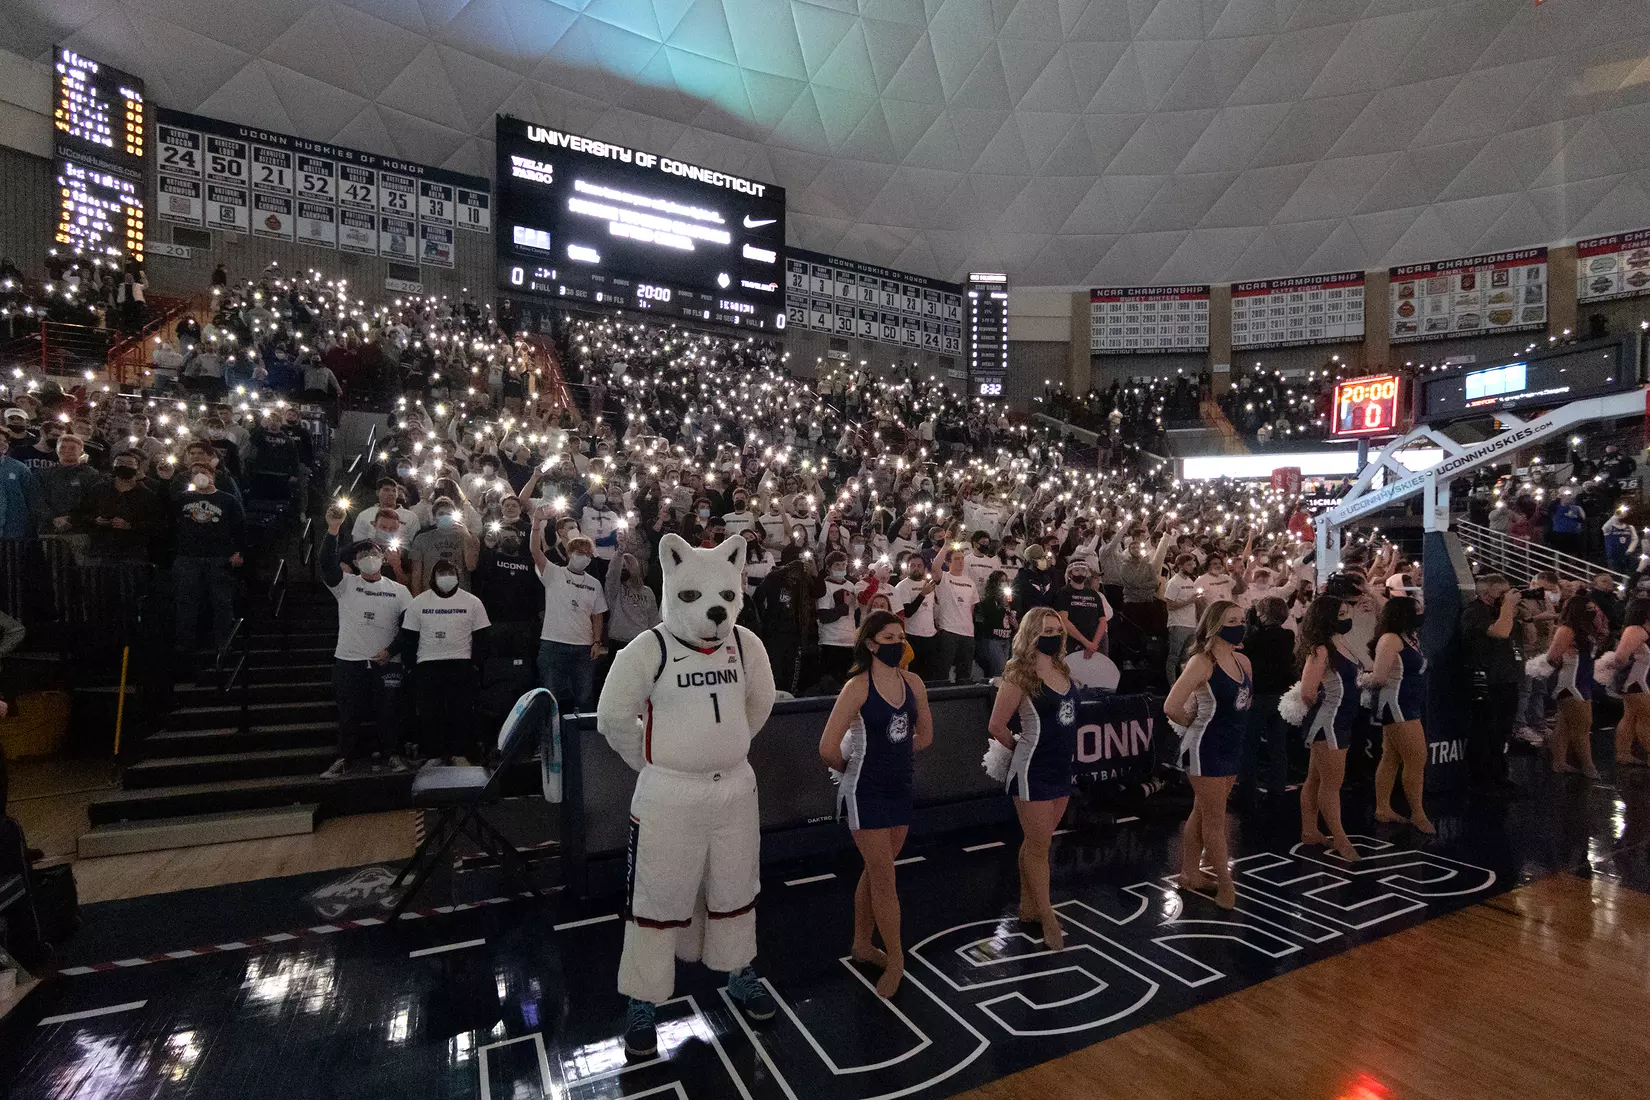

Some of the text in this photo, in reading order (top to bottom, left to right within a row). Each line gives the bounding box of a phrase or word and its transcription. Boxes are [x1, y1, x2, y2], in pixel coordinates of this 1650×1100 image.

[163, 146, 196, 168] 24
[239, 128, 424, 174] UCONN HUSKIES OF HONOR
[211, 155, 242, 177] 50
[511, 155, 553, 174] WELLS
[527, 125, 766, 197] UNIVERSITY OF CONNECTICUT
[261, 166, 284, 185] 21
[512, 166, 553, 184] FARGO
[303, 174, 329, 194] 52
[344, 184, 372, 202] 42
[388, 191, 407, 209] 25
[429, 199, 444, 216] 33
[467, 207, 480, 223] 10
[1580, 237, 1617, 249] NCAA
[166, 245, 191, 257] 201
[828, 258, 854, 268] UCONN
[1397, 250, 1538, 275] NCAA CHAMPIONSHIP
[511, 266, 524, 285] 0
[792, 274, 803, 287] 32
[1238, 273, 1357, 291] NCAA CHAMPIONSHIP
[402, 282, 423, 293] 202
[535, 282, 551, 292] FULL
[636, 284, 671, 302] 20:00
[819, 280, 824, 292] 3
[1097, 286, 1203, 297] NCAA CHAMPIONSHIP
[864, 289, 873, 301] 20
[886, 293, 894, 306] 31
[907, 298, 916, 310] 23
[928, 302, 937, 314] 31
[790, 308, 804, 322] 23
[948, 306, 957, 318] 14
[776, 313, 786, 330] 0
[818, 314, 825, 326] 4
[839, 317, 852, 331] 30
[865, 322, 872, 334] 3
[884, 326, 896, 339] CD
[906, 330, 916, 342] 15
[925, 333, 939, 346] 24
[1389, 334, 1445, 344] CONNECTICUT
[946, 338, 959, 350] 33
[980, 384, 1001, 395] 8:32
[1341, 381, 1395, 403] 20:00
[1365, 402, 1382, 428] 0
[1436, 421, 1554, 476] UCONNHUSKIES.COM
[1347, 474, 1425, 516] UCONNHUSKIES
[496, 560, 529, 571] UCONN
[677, 669, 738, 688] UCONN
[710, 692, 721, 724] 1
[1071, 717, 1154, 763] ONN
